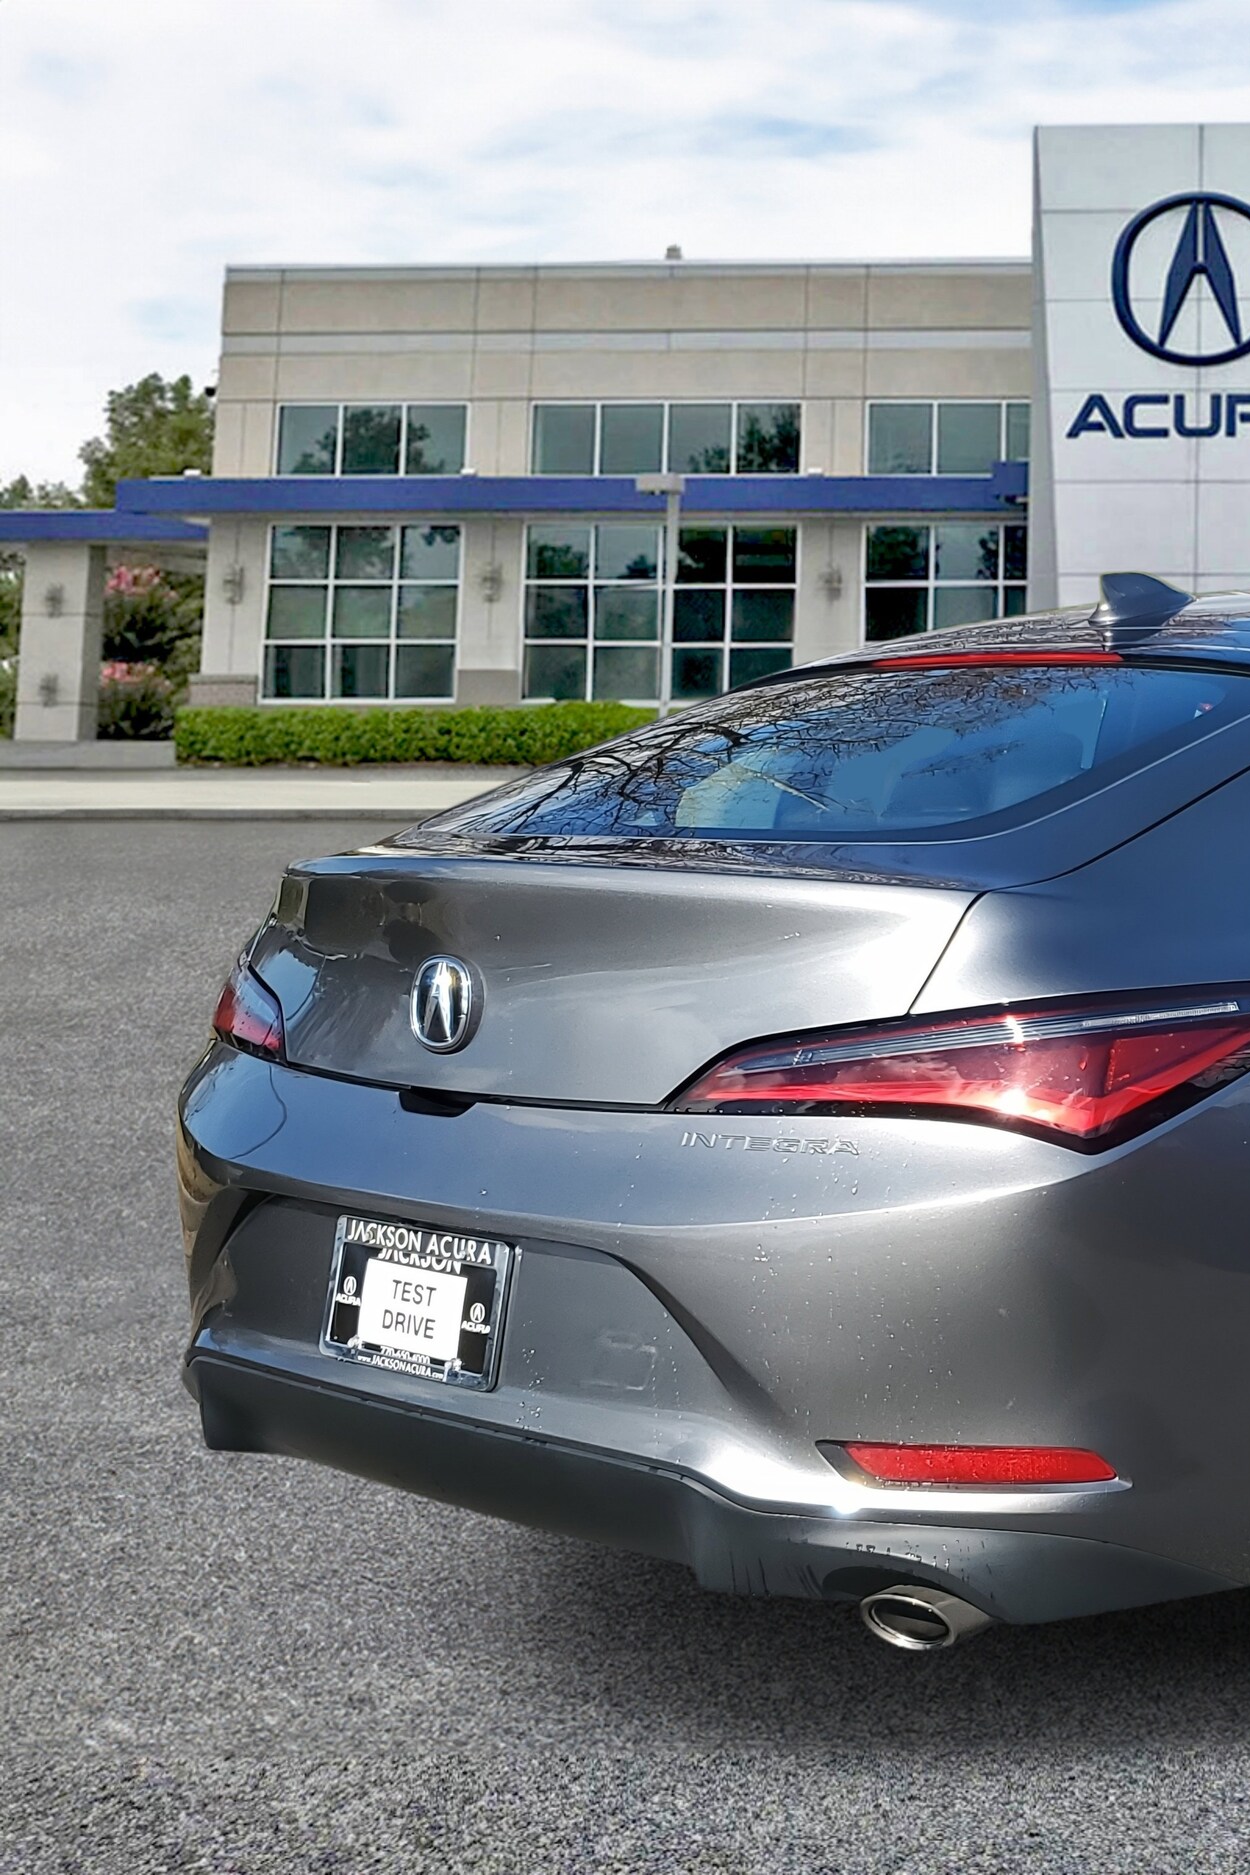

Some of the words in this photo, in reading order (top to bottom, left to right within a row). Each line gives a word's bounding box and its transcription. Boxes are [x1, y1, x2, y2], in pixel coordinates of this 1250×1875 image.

[681, 1132, 860, 1155] INTEGRA
[348, 1219, 422, 1253] JACKSON
[426, 1233, 492, 1265] ACURA
[392, 1279, 437, 1307] TEST
[382, 1309, 436, 1340] DRIVE
